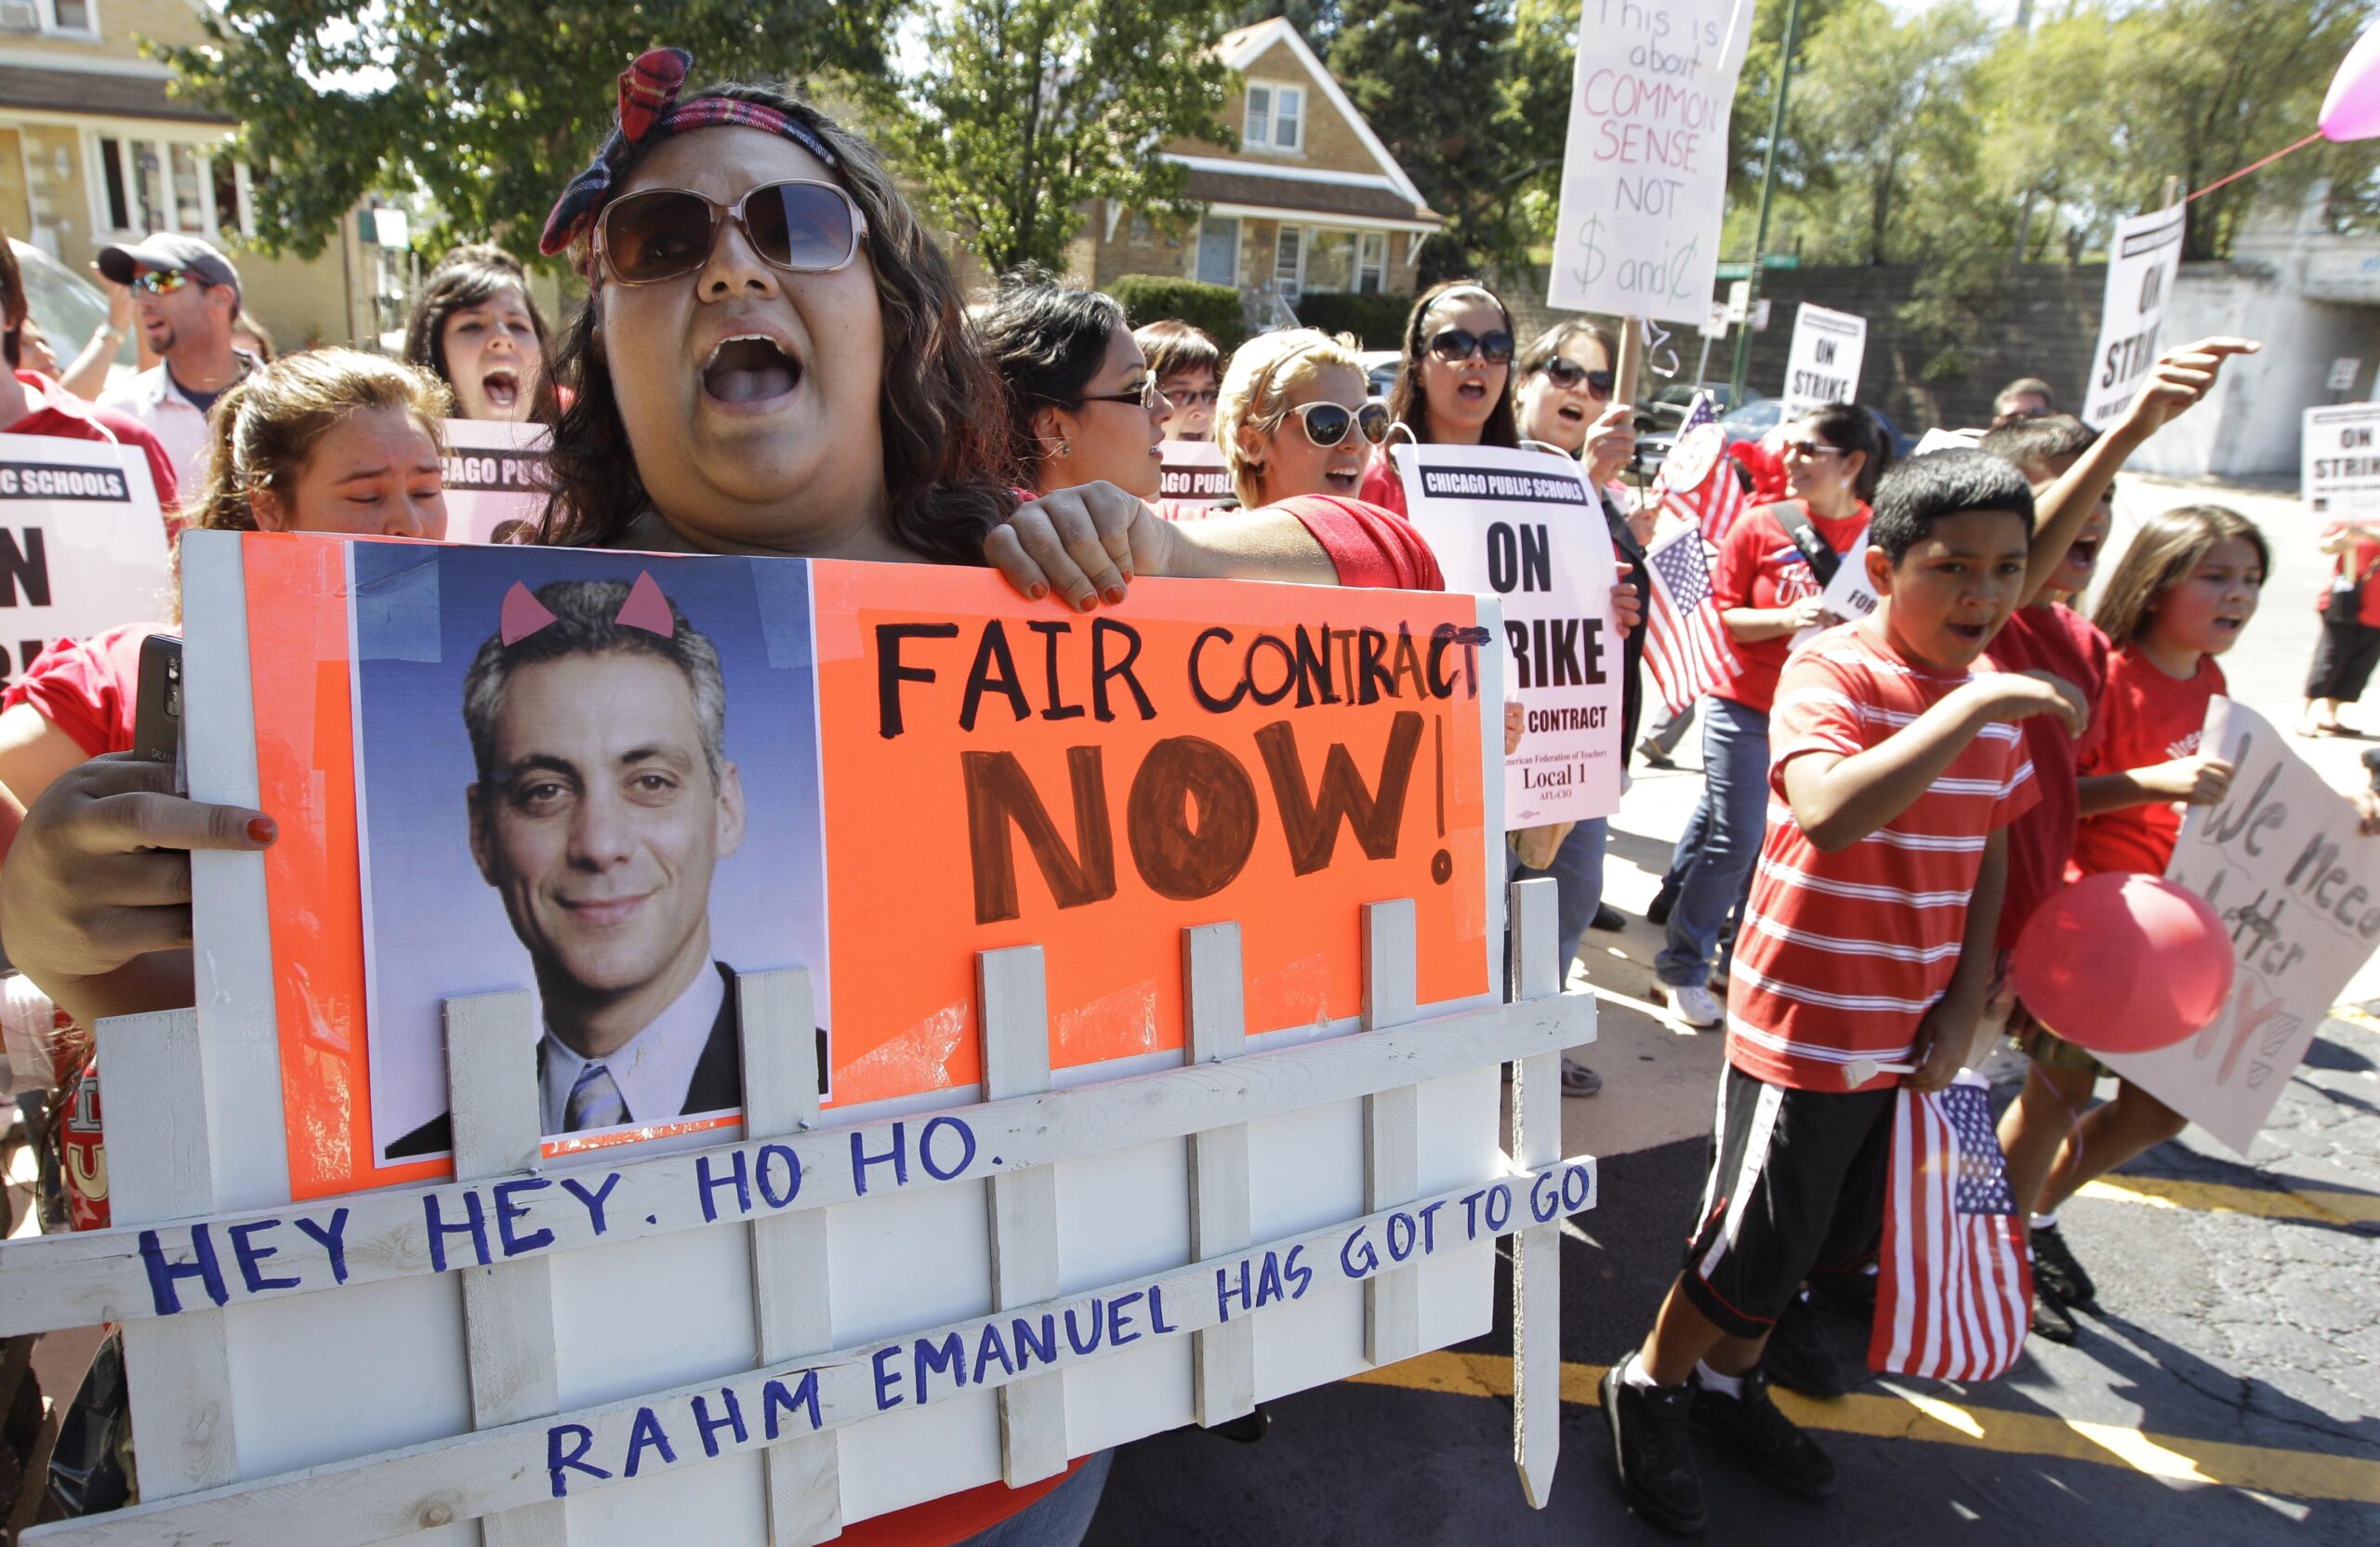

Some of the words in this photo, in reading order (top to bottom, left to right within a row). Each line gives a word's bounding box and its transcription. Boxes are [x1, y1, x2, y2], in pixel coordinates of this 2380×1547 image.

[1692, 19, 1719, 46] is
[1630, 35, 1702, 81] about
[1583, 68, 1719, 133] COMMON
[1593, 119, 1700, 174] SENSE
[1615, 176, 1685, 219] NOT
[1573, 212, 1607, 294] $
[1816, 337, 1837, 364] ON
[1792, 369, 1849, 403] STRIKE
[2340, 428, 2372, 448] ON
[22, 469, 125, 498] SCHOOLS
[1194, 472, 1236, 495] PUBLI
[1425, 471, 1488, 495] CHICAGO
[1488, 475, 1533, 497] PUBLIC
[1533, 478, 1584, 501] SCHOOLS
[1488, 521, 1552, 593] ON
[1504, 617, 1606, 689] RIKE
[877, 617, 1157, 739] FAIR
[1188, 620, 1492, 712] CONTRACT
[1527, 706, 1607, 734] CONTRACT
[1505, 756, 1533, 766] merican
[1535, 753, 1571, 764] Federation
[1572, 750, 1580, 760] of
[1580, 748, 1607, 759] Teachers
[1523, 763, 1572, 789] Local
[1580, 763, 1586, 784] 1
[1540, 788, 1572, 800] AFL-CIO
[960, 710, 1453, 926] NOW!
[138, 1208, 350, 1316] HEY
[425, 1173, 656, 1274] HEY.
[696, 1144, 802, 1223] HO
[851, 1117, 1003, 1197] HO.
[549, 1369, 823, 1498] RAHM
[873, 1285, 1178, 1411] EMANUEL
[1216, 1243, 1314, 1322] HAS
[1340, 1200, 1447, 1279] GOT
[1460, 1183, 1513, 1240] TO
[1529, 1165, 1591, 1223] GO
